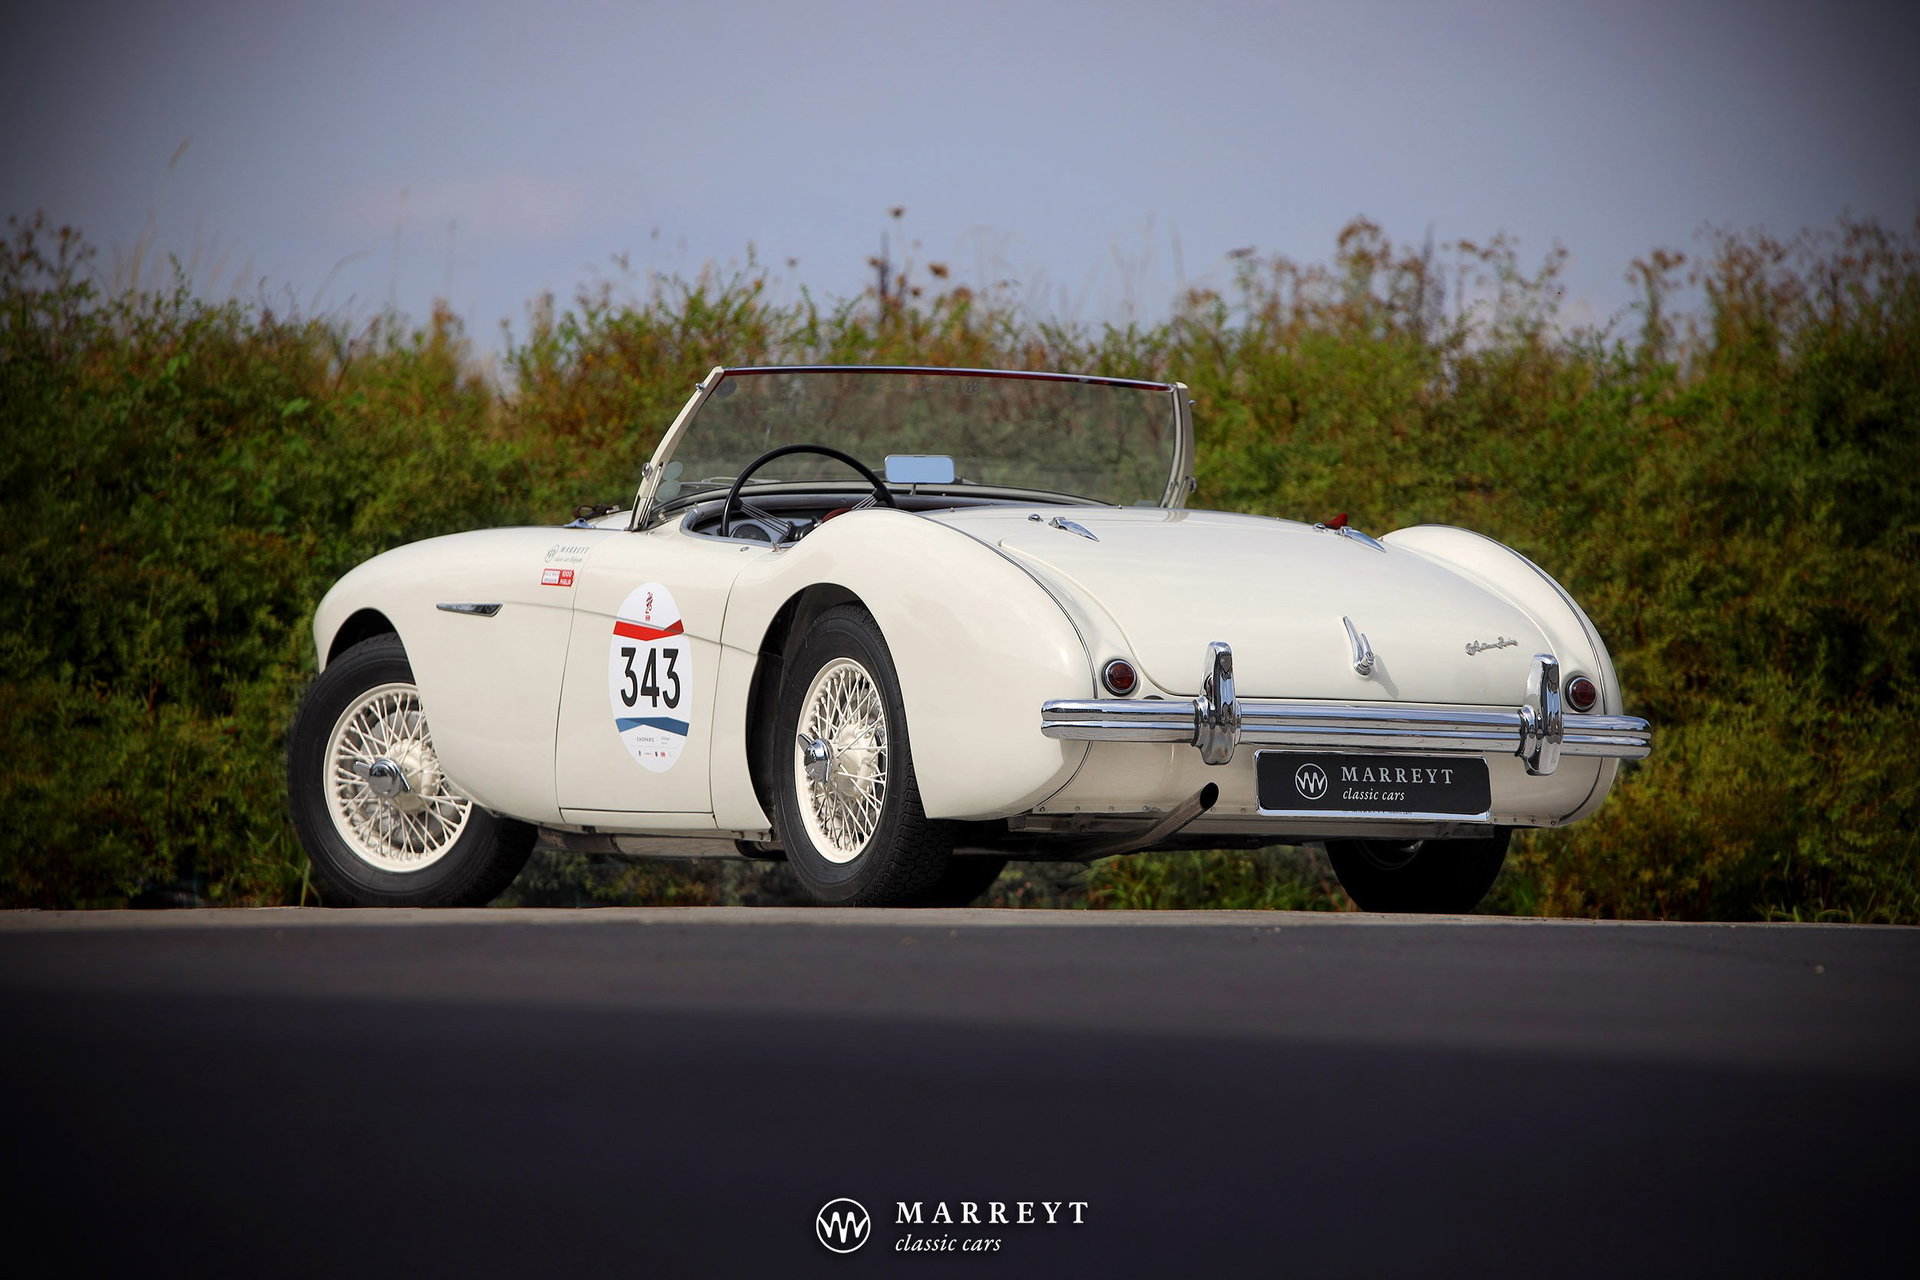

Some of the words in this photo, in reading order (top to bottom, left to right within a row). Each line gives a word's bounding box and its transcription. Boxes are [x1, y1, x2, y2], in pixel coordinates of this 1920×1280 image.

[620, 647, 681, 709] 343
[1341, 766, 1454, 785] MARREYT
[1342, 788, 1379, 801] classic
[1381, 790, 1405, 801] cars
